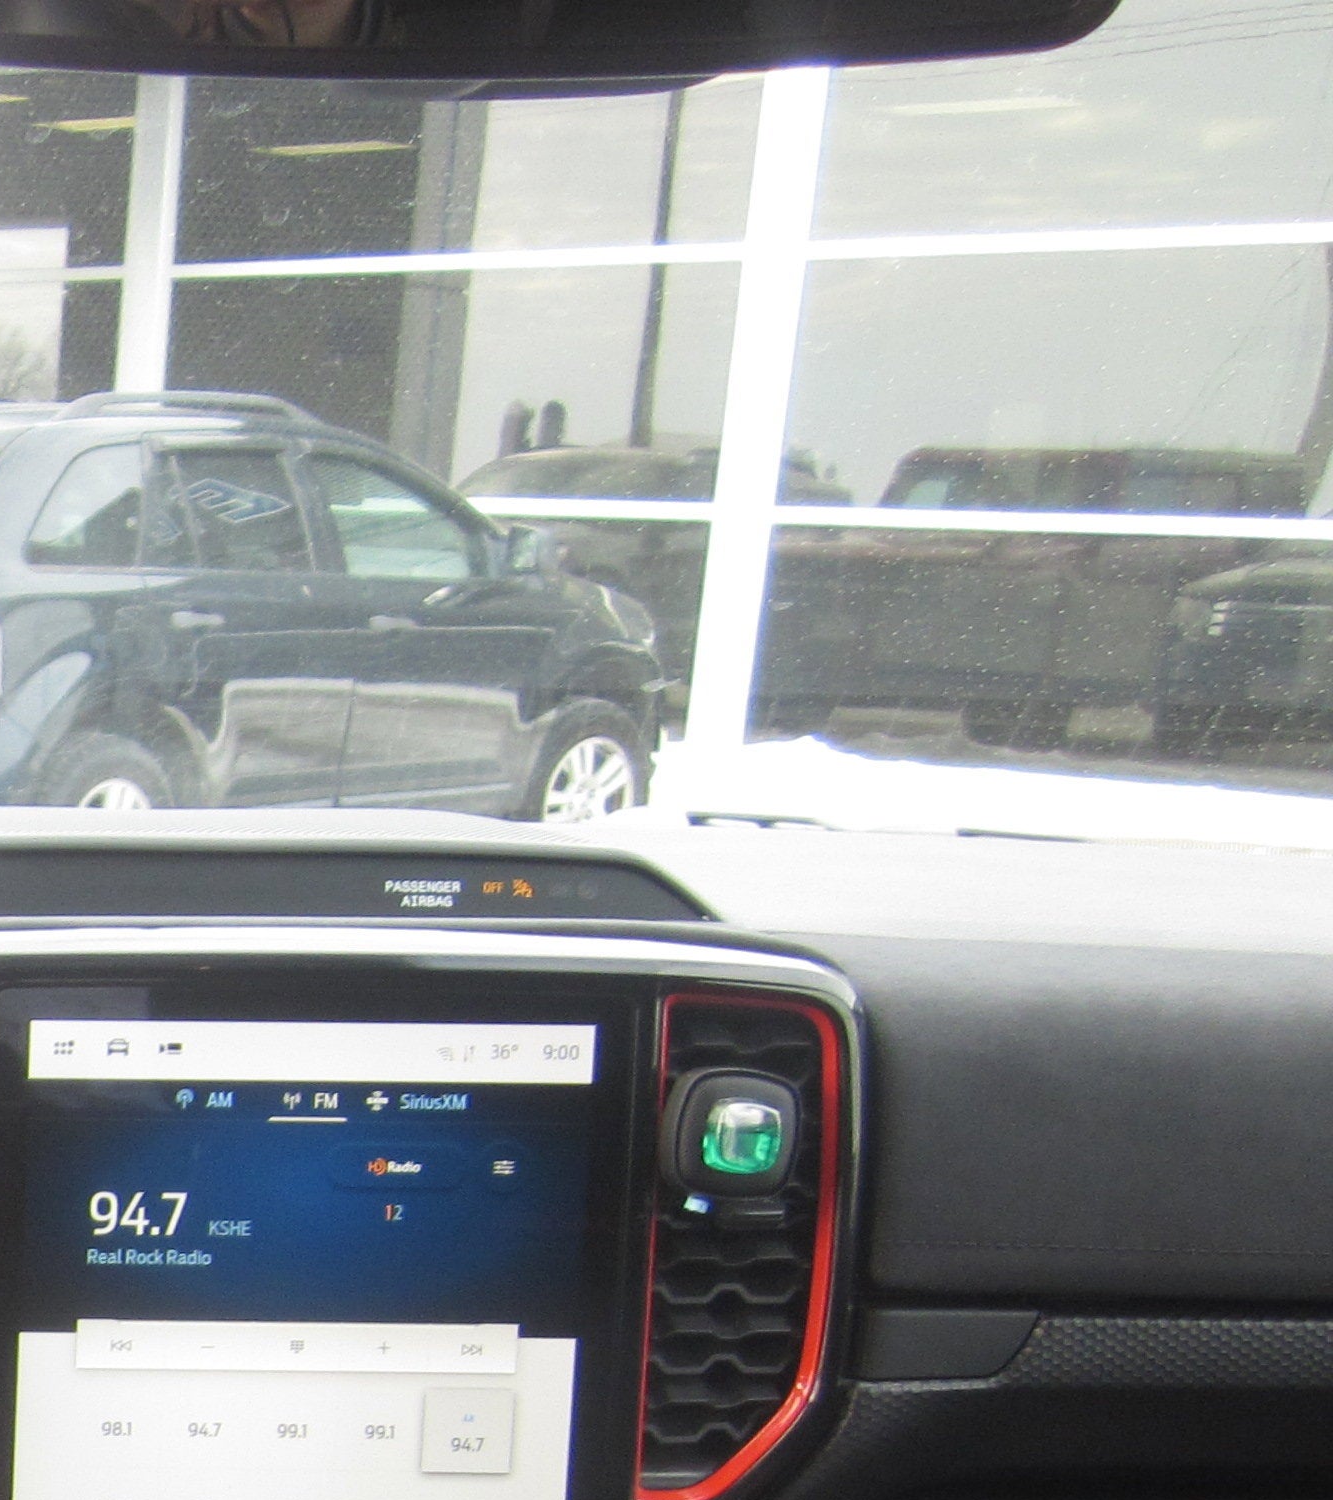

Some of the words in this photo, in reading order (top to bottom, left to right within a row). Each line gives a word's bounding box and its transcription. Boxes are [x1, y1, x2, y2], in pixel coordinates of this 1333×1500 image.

[384, 880, 461, 893] PASSENGER
[482, 881, 504, 894] OFF
[400, 895, 453, 908] AIRBAG
[491, 1044, 519, 1060] 36°
[542, 1044, 581, 1061] 9:00
[206, 1092, 234, 1109] AM
[314, 1092, 339, 1110] FM
[399, 1093, 469, 1111] SiriusXM
[89, 1191, 188, 1237] 94.7
[208, 1220, 252, 1237] KSHE
[86, 1248, 122, 1265] Real
[125, 1249, 163, 1265] Rock
[166, 1249, 212, 1266] Radio
[101, 1421, 133, 1437] 98.1
[187, 1422, 222, 1437] 94.7
[277, 1423, 308, 1439] 99.1
[364, 1424, 396, 1440] 99.1
[450, 1437, 485, 1452] 94.7
